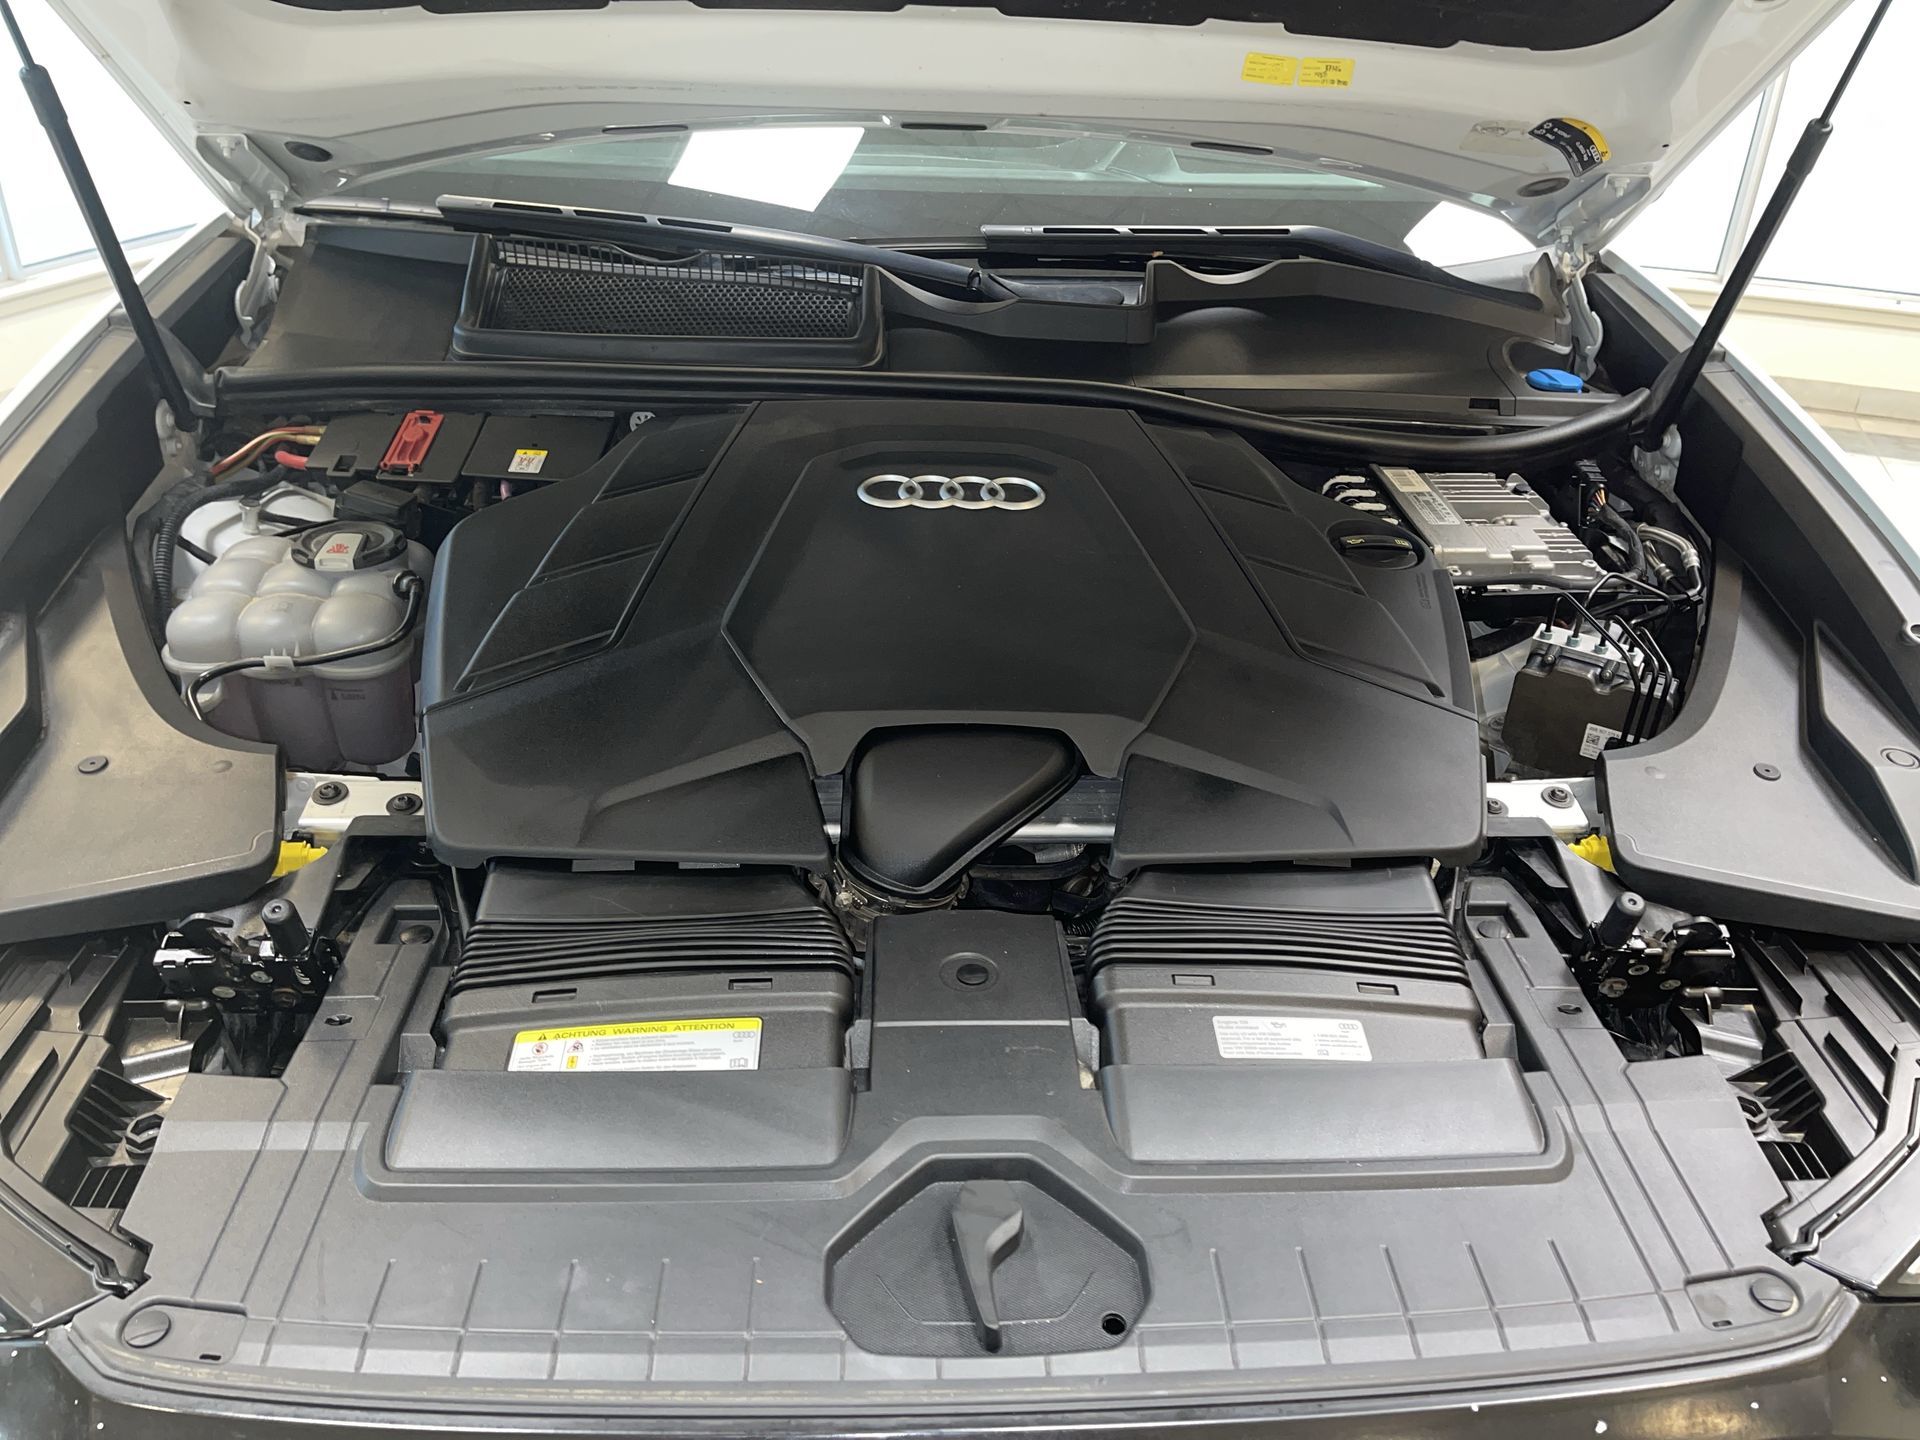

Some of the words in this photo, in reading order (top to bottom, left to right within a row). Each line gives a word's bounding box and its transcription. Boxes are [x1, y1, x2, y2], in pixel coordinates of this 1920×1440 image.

[553, 1029, 607, 1040] ACHTUNG
[612, 1026, 667, 1035] WARNING
[673, 1023, 735, 1032] ATTENTION
